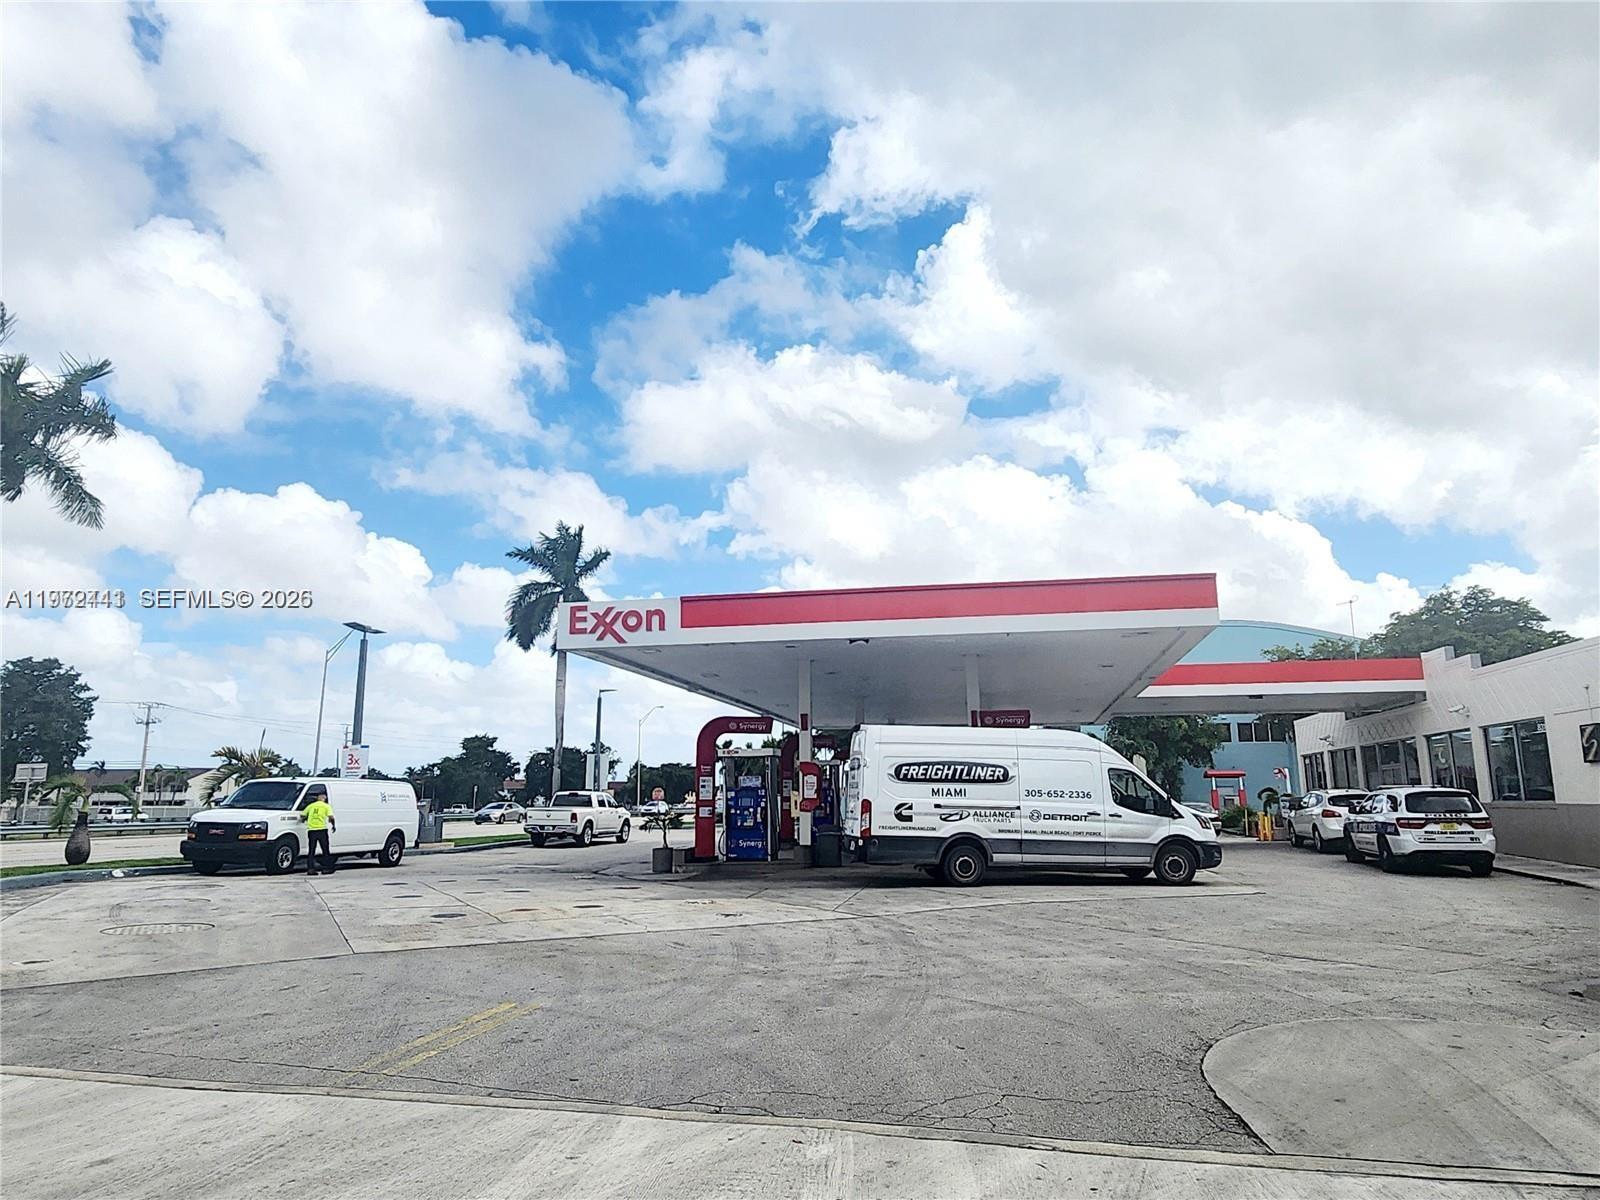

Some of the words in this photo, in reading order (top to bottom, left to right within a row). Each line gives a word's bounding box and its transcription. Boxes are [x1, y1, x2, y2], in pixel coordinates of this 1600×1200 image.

[568, 605, 666, 644] Exxon
[995, 716, 1026, 725] Synergy
[739, 722, 767, 731] Synergy
[899, 764, 1005, 781] FREIGHTLINER
[931, 787, 967, 798] MIAMI
[1024, 788, 1093, 800] 305-652-2336
[972, 810, 1016, 819] ALLIANCE
[1042, 813, 1089, 822] DETROIT
